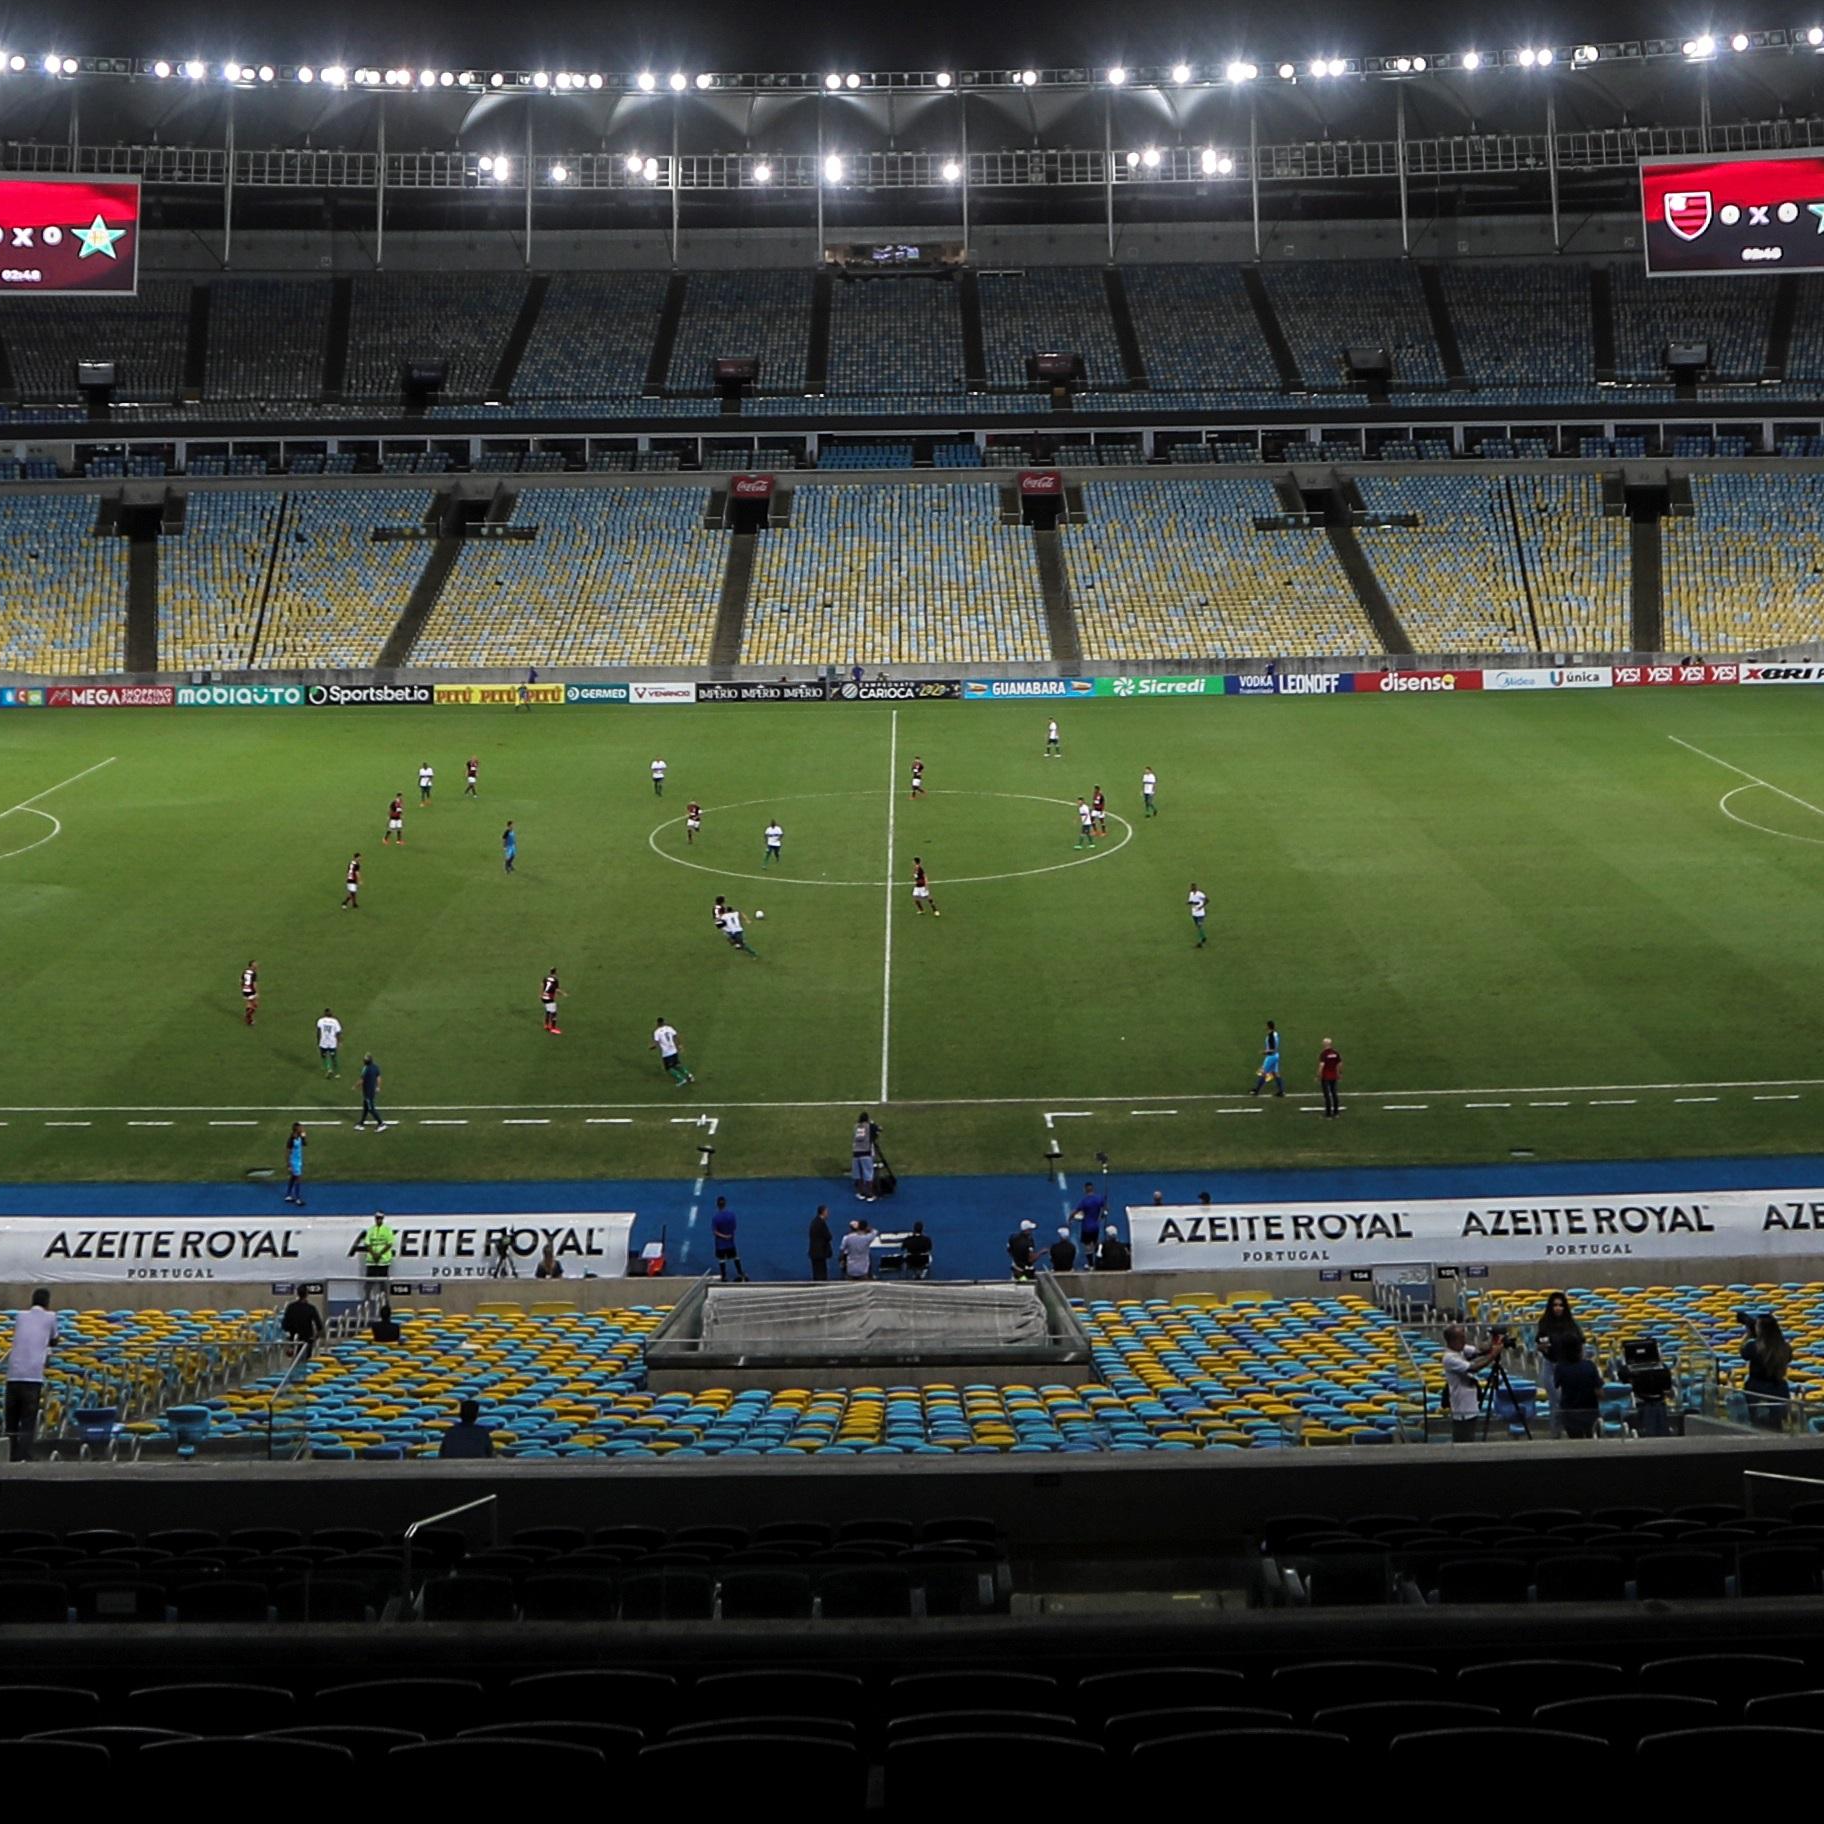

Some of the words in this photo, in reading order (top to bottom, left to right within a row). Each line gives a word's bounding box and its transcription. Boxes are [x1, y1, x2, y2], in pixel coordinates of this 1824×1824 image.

[42, 225, 64, 247] 0
[1566, 671, 1600, 684] única
[1615, 667, 1641, 683] YES!
[1647, 667, 1673, 683] YES!
[1679, 666, 1705, 682] YES!
[992, 681, 1066, 696] GUANABARA
[1138, 677, 1206, 694] Sicredi
[1239, 675, 1274, 688] VODKA
[1279, 674, 1341, 694] LEONOFF
[71, 689, 123, 705] MEGA
[328, 686, 429, 706] Sportsbet.io
[581, 689, 627, 699] GERMED
[859, 688, 915, 699] CARIOCA
[1157, 1216, 1285, 1244] AZEITE
[1291, 1212, 1414, 1241] ROYAL
[1461, 1208, 1588, 1236] AZEITE
[1593, 1205, 1716, 1234] ROYAL
[43, 1231, 176, 1259] AZEITE
[180, 1230, 301, 1258] ROYAL
[1546, 1244, 1633, 1256] PORTUGAL
[1242, 1250, 1330, 1263] PORTUGAL
[127, 1268, 215, 1280] PORTUGAL
